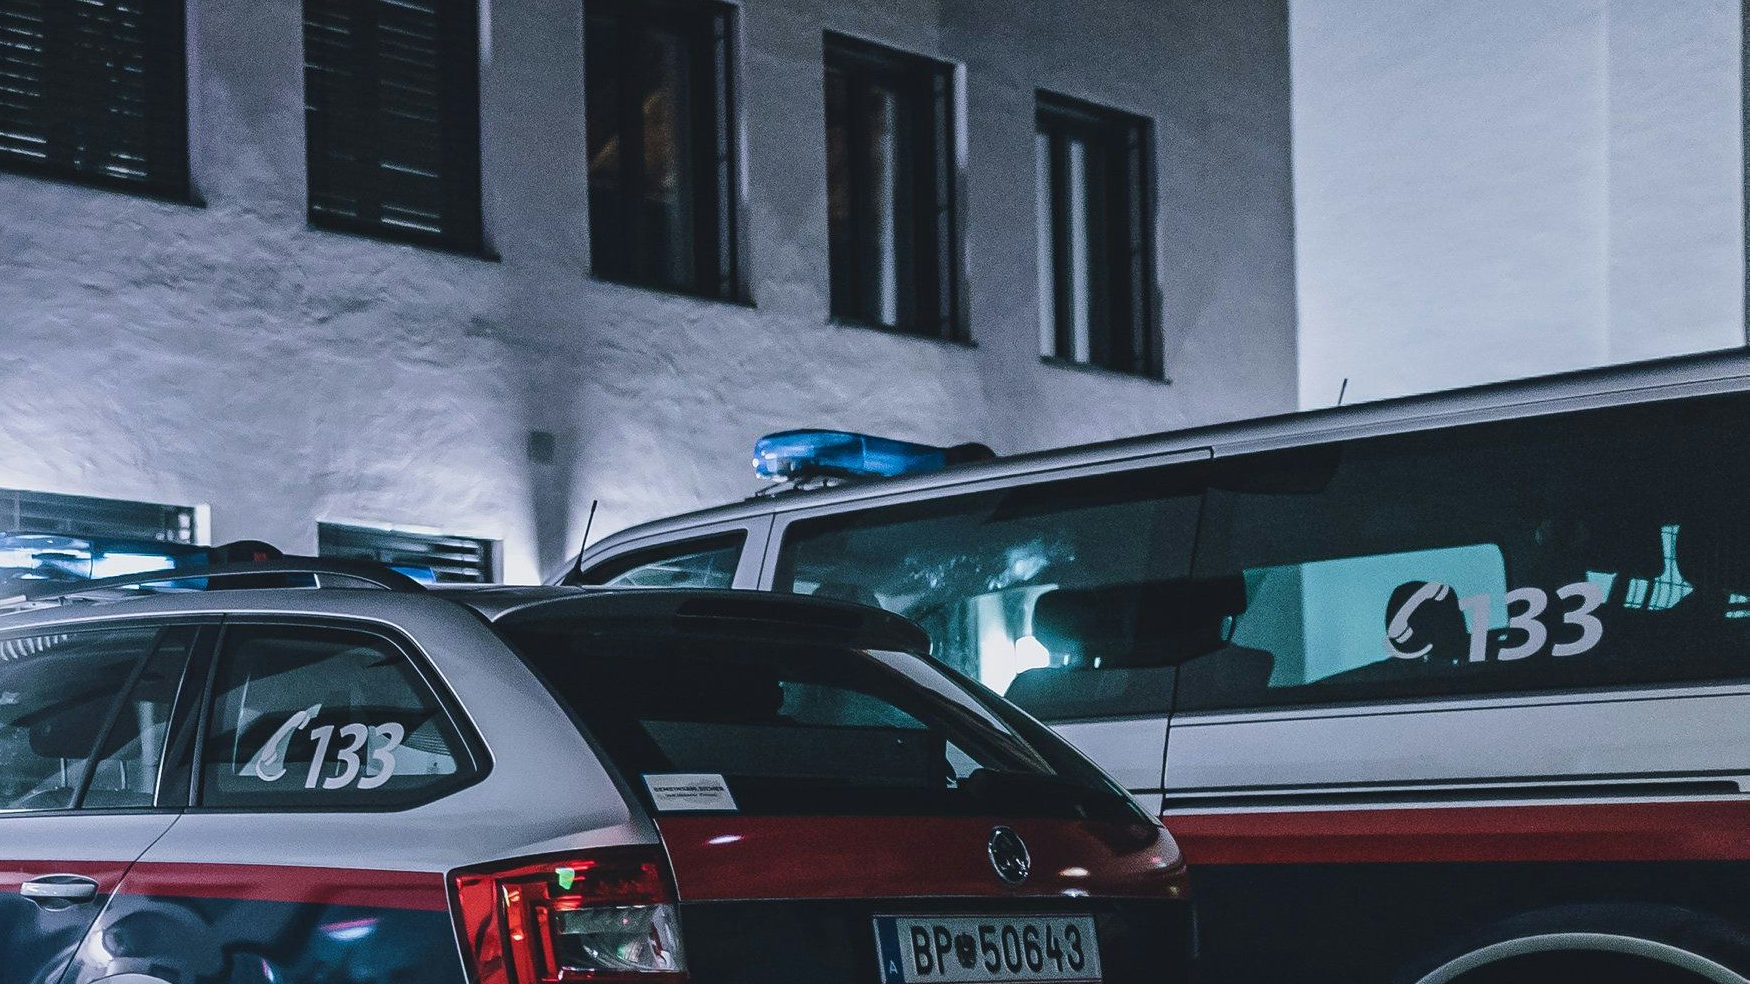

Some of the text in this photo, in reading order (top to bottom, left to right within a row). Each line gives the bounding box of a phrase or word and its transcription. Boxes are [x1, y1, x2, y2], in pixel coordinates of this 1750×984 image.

[1459, 582, 1604, 662] 133
[305, 722, 404, 789] 133
[889, 924, 1085, 976] A BP 50643
